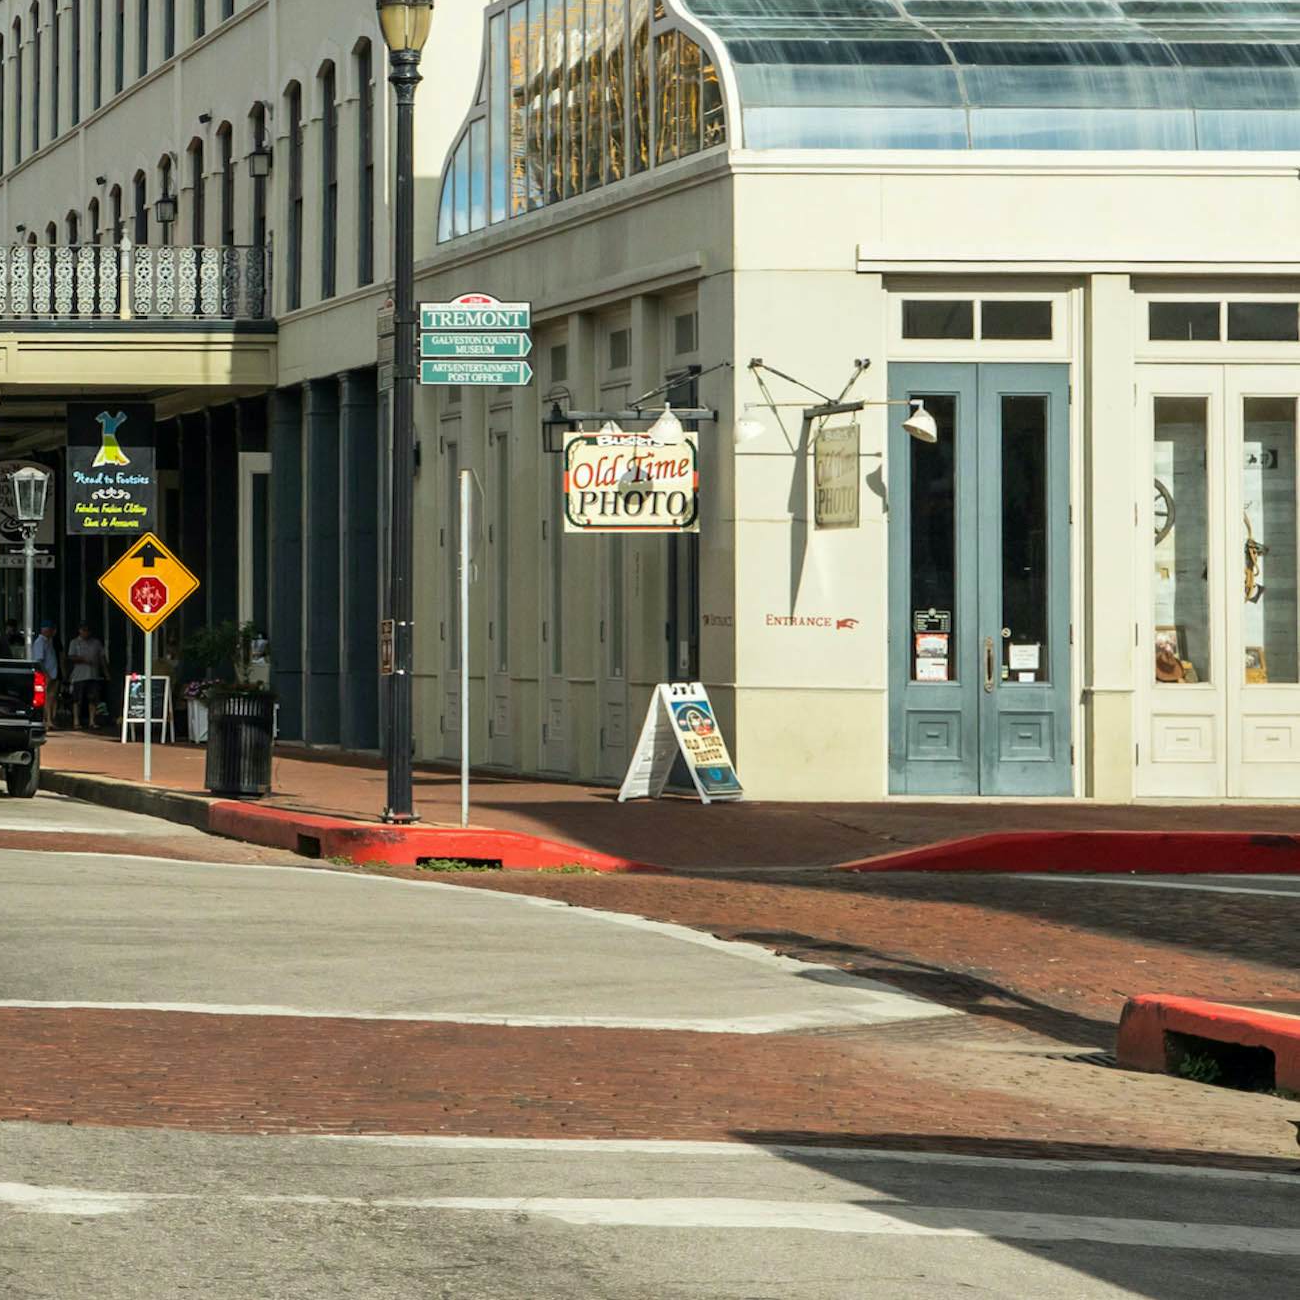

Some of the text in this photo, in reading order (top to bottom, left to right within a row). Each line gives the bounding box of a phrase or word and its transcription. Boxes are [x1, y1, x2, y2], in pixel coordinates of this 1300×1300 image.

[427, 311, 523, 326] TREMONT
[431, 336, 518, 345] GALVESTON COUNTY
[455, 345, 496, 354] MUSEUM
[447, 373, 504, 382] POST OFFICE
[573, 452, 689, 489] Old Time
[105, 475, 114, 484] to
[578, 490, 687, 516] PHOTO
[765, 613, 832, 627] ENTRANCE
[702, 736, 723, 747] TIME
